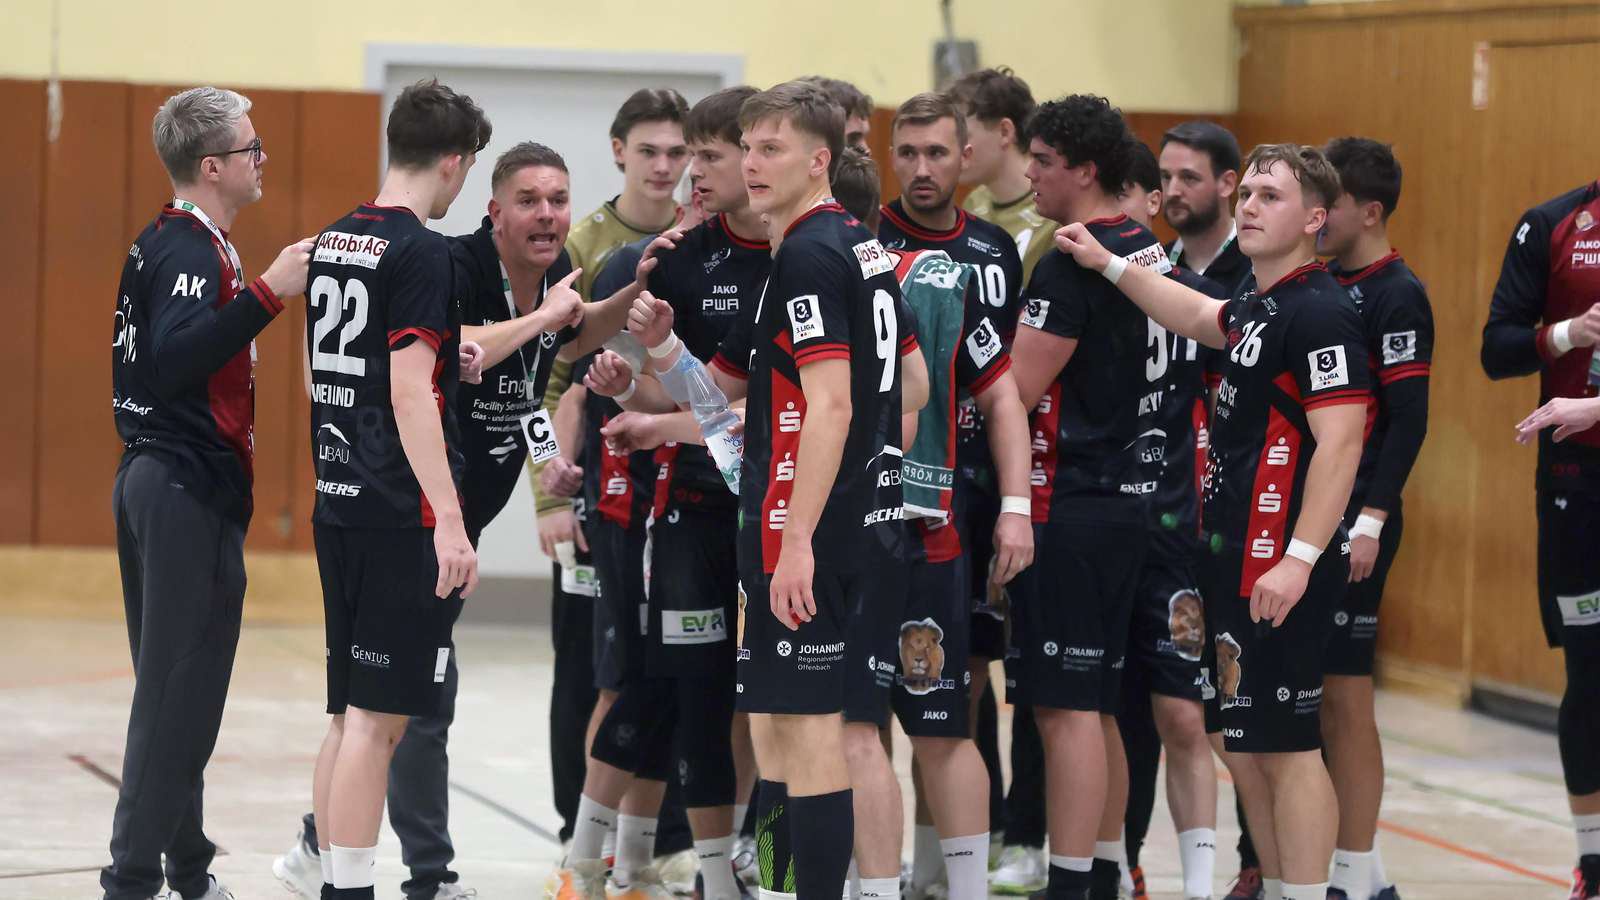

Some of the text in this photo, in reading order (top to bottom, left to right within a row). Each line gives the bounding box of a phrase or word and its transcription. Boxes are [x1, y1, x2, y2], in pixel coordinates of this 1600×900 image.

[318, 233, 387, 256] Aktobs AG
[1516, 222, 1531, 245] 4
[1571, 253, 1600, 265] PW
[171, 273, 207, 300] AK
[712, 285, 738, 295] JAKO
[702, 298, 740, 311] PWA
[310, 275, 369, 376] 22
[872, 288, 898, 393] 9
[1230, 320, 1268, 368] 26
[471, 411, 487, 421] Glas
[473, 398, 505, 413] Facility
[527, 416, 549, 444] C
[923, 710, 948, 720] JAKO
